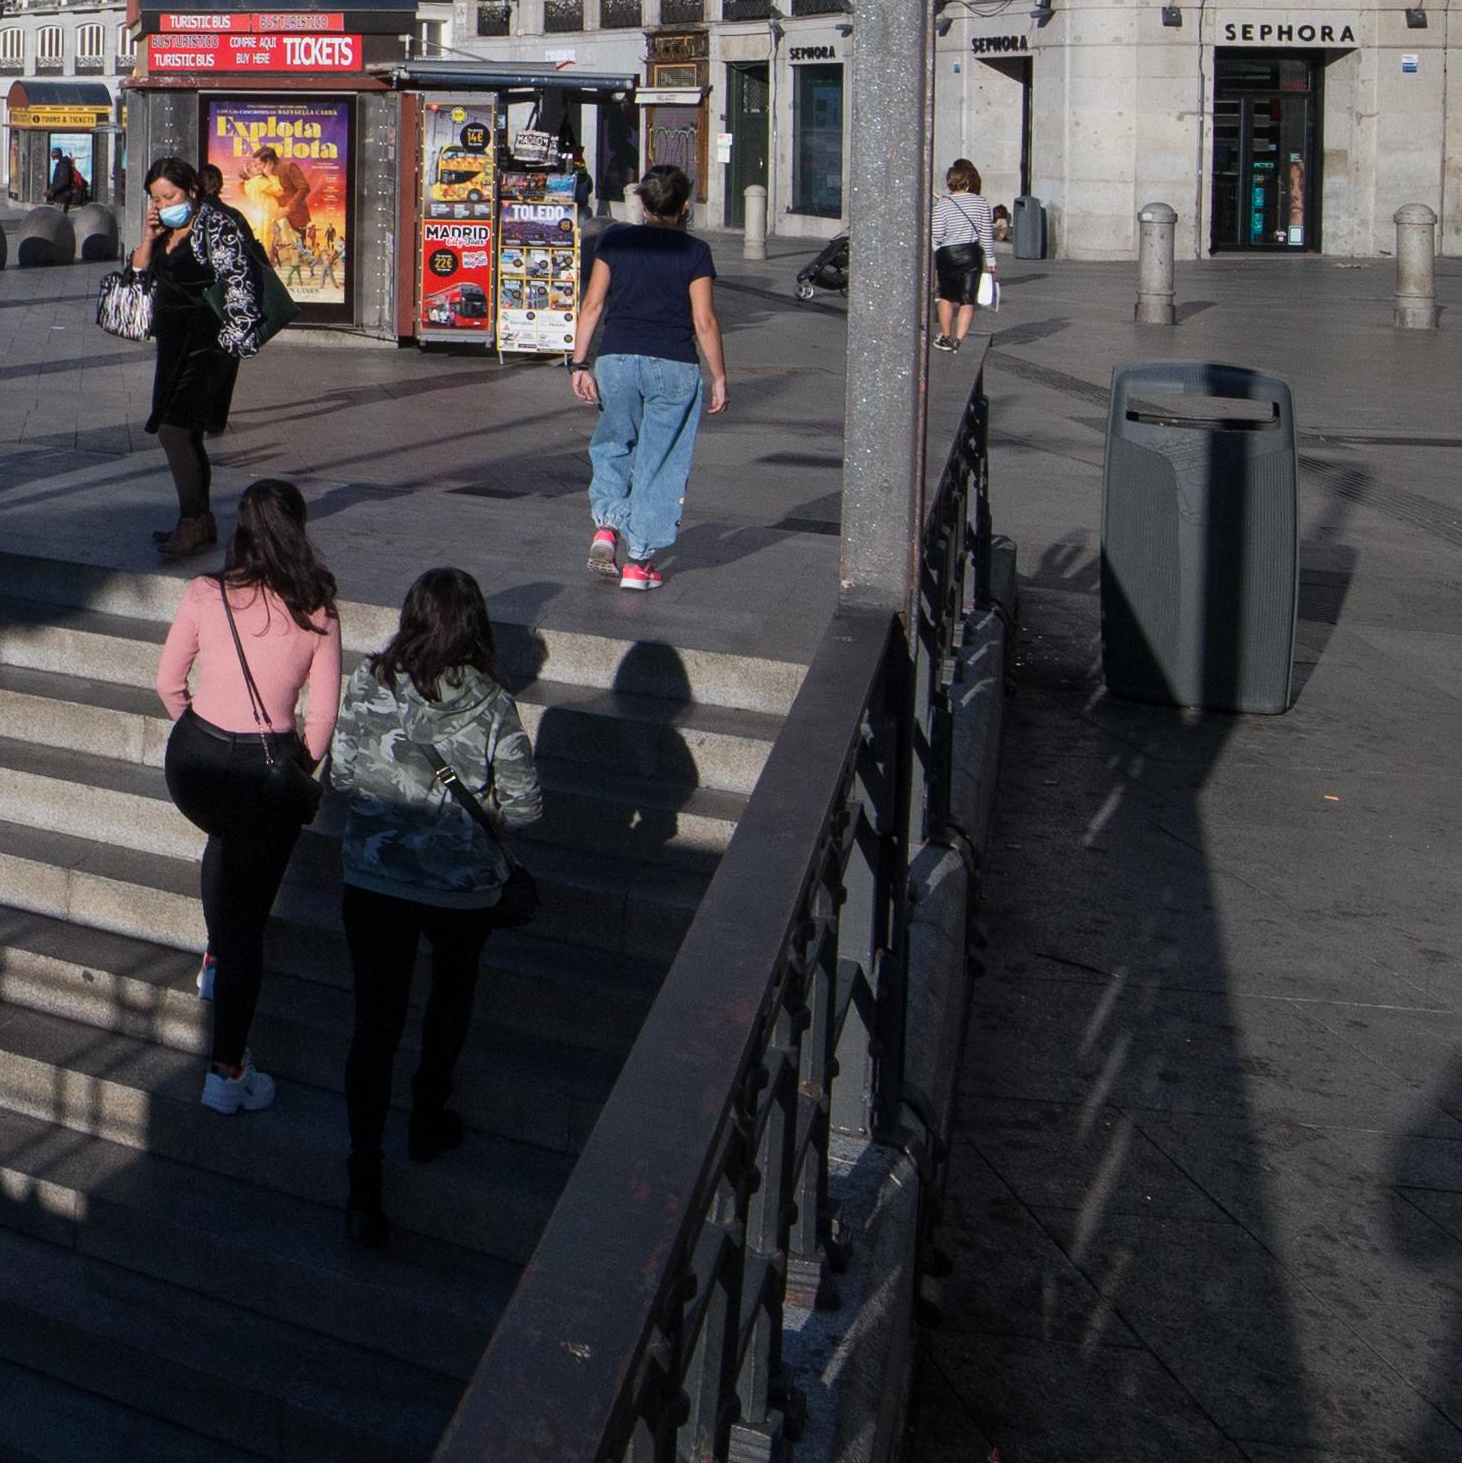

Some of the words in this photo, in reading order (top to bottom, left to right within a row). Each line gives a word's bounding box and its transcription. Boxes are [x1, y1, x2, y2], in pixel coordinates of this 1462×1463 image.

[169, 15, 212, 28] TURISTIC
[213, 15, 231, 29] BUS
[259, 14, 279, 28] BUS
[280, 15, 328, 29] TURISTICO
[1224, 22, 1356, 43] SEPHORA
[152, 34, 170, 48] BUS
[171, 35, 219, 48] TURISTICO
[229, 36, 257, 48] COMPRE
[971, 34, 1029, 54] SEPHORA
[235, 53, 250, 65] BUY
[252, 53, 271, 65] HERE
[283, 37, 353, 66] TICKETS
[789, 45, 836, 60] SEPHORA
[154, 54, 197, 67] TURISTIC
[197, 54, 215, 67] BUS
[217, 116, 322, 142] Explota
[467, 132, 484, 143] 14€
[233, 137, 339, 159] Explota
[511, 205, 564, 220] TOLEDO
[426, 225, 489, 240] MADRID
[434, 258, 453, 268] 22€
